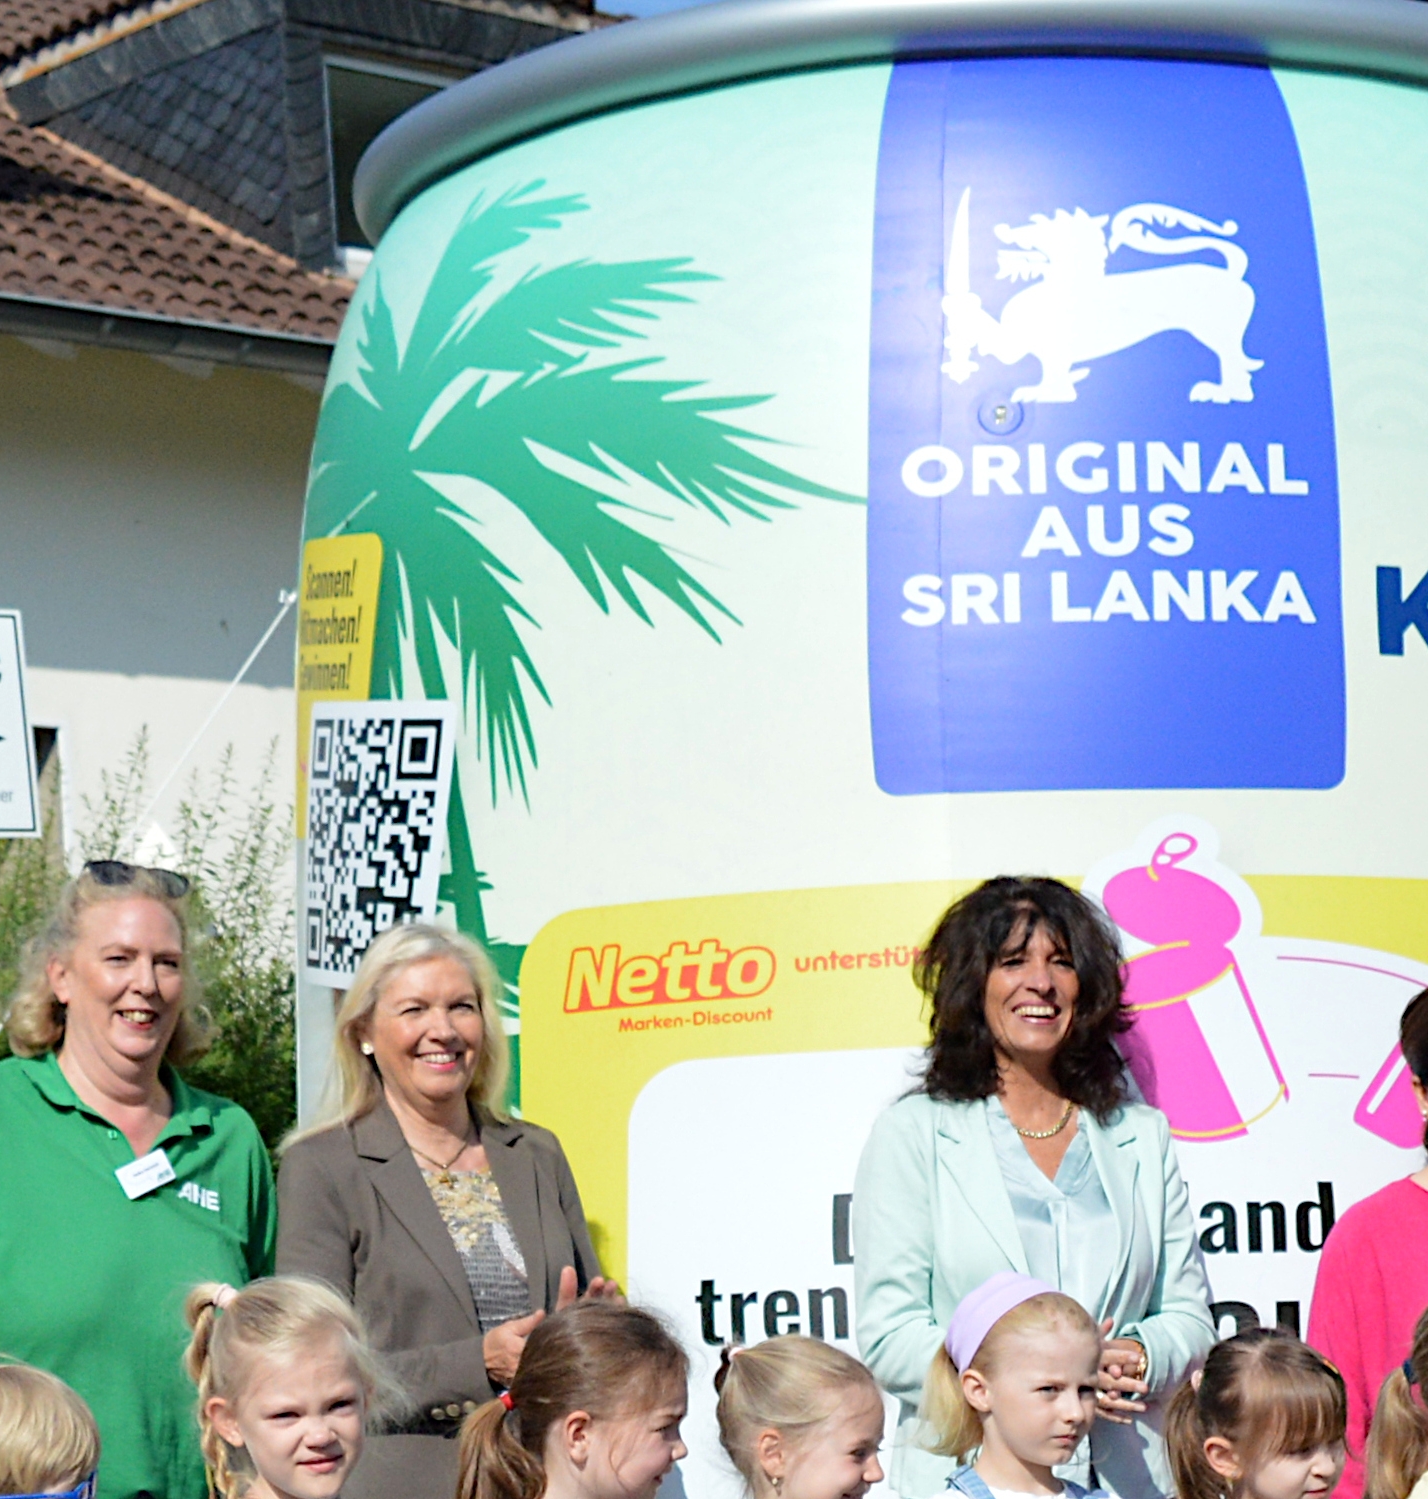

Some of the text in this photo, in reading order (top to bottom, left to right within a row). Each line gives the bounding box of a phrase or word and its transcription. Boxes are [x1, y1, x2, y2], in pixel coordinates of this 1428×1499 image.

[900, 441, 1309, 498] ORIGINAL
[1021, 503, 1194, 557] AUS
[900, 569, 1317, 627] SRI LANKA
[563, 939, 922, 1014] Netto unterstüt
[618, 1007, 774, 1033] Marken-Discount
[177, 1181, 221, 1212] AHE
[695, 1279, 849, 1346] tren
